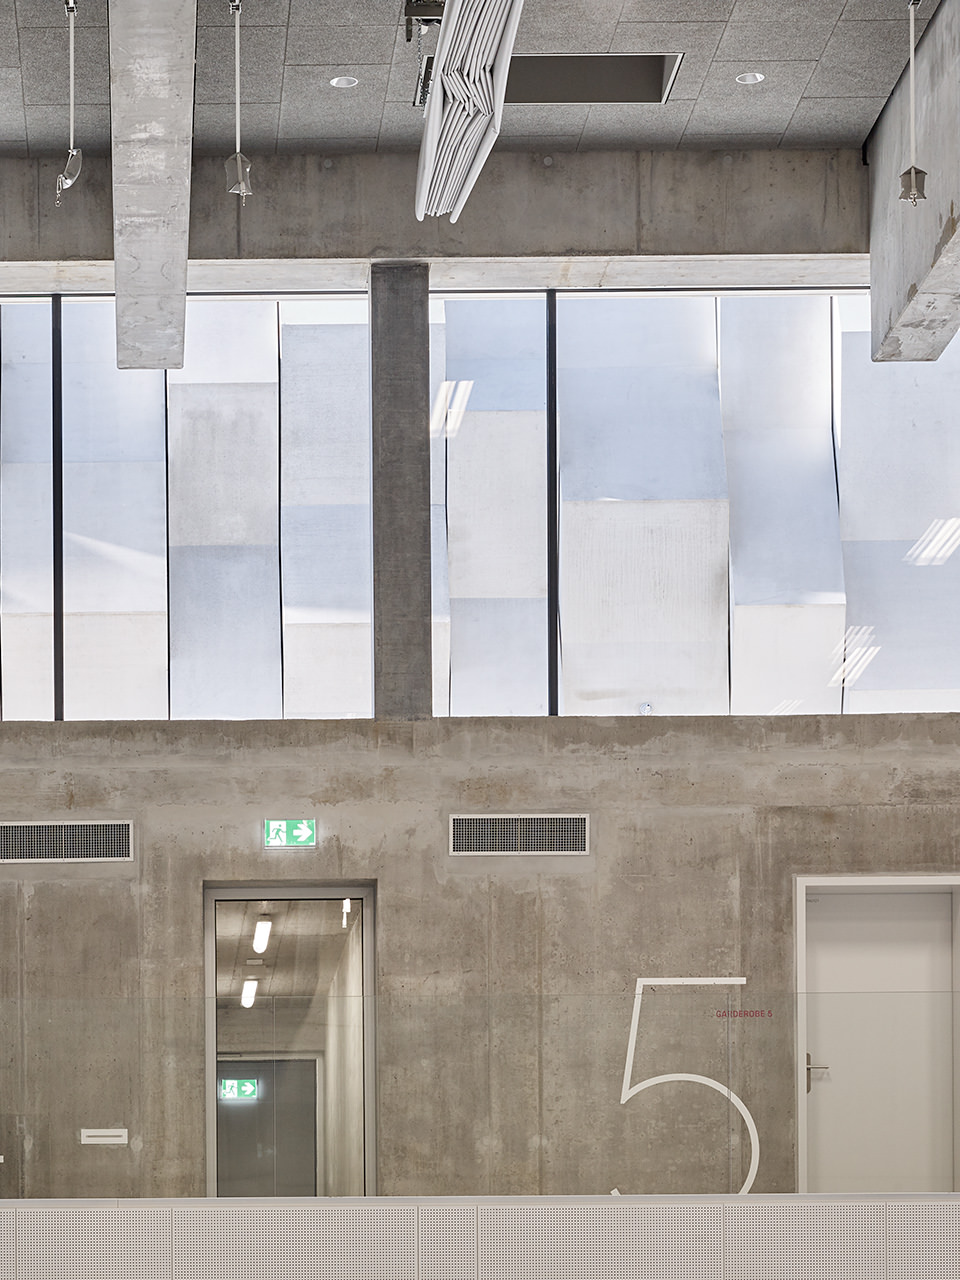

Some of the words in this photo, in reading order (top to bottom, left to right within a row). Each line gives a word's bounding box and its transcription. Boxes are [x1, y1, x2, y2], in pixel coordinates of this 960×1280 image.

[716, 1009, 766, 1018] GARDEROBE
[767, 1009, 773, 1018] 5
[610, 977, 760, 1195] 5
